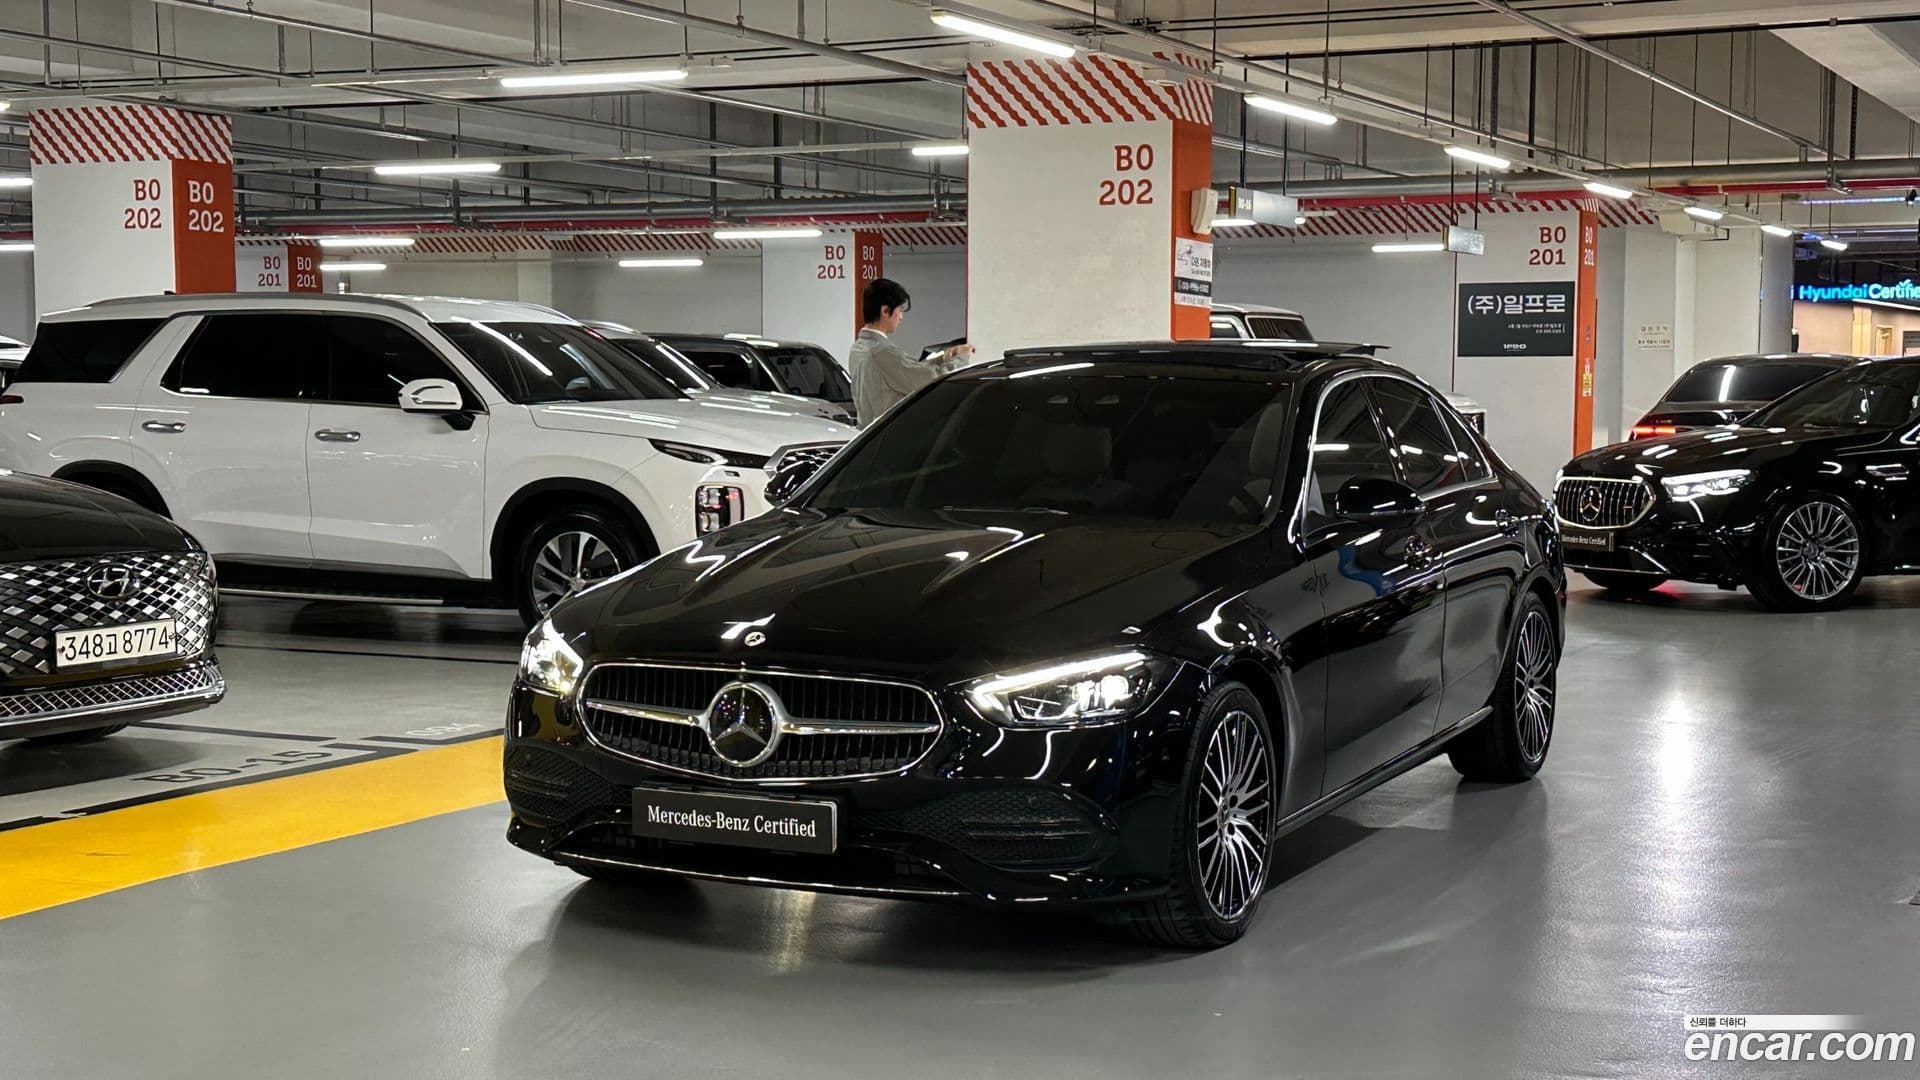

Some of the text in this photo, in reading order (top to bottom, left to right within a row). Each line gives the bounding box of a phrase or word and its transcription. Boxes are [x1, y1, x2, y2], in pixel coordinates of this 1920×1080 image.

[1099, 178, 1154, 206] 202
[124, 207, 162, 229] 202
[188, 209, 224, 233] 202
[1529, 248, 1567, 266] 201
[258, 273, 281, 287] 201
[296, 273, 317, 288] 201
[817, 265, 846, 279] 201
[862, 264, 878, 280] 201
[1799, 283, 1868, 302] Hyundai
[1467, 294, 1566, 315] (주)일프로
[123, 626, 169, 654] 8774
[648, 805, 816, 837] Mercedes-Benz Certified
